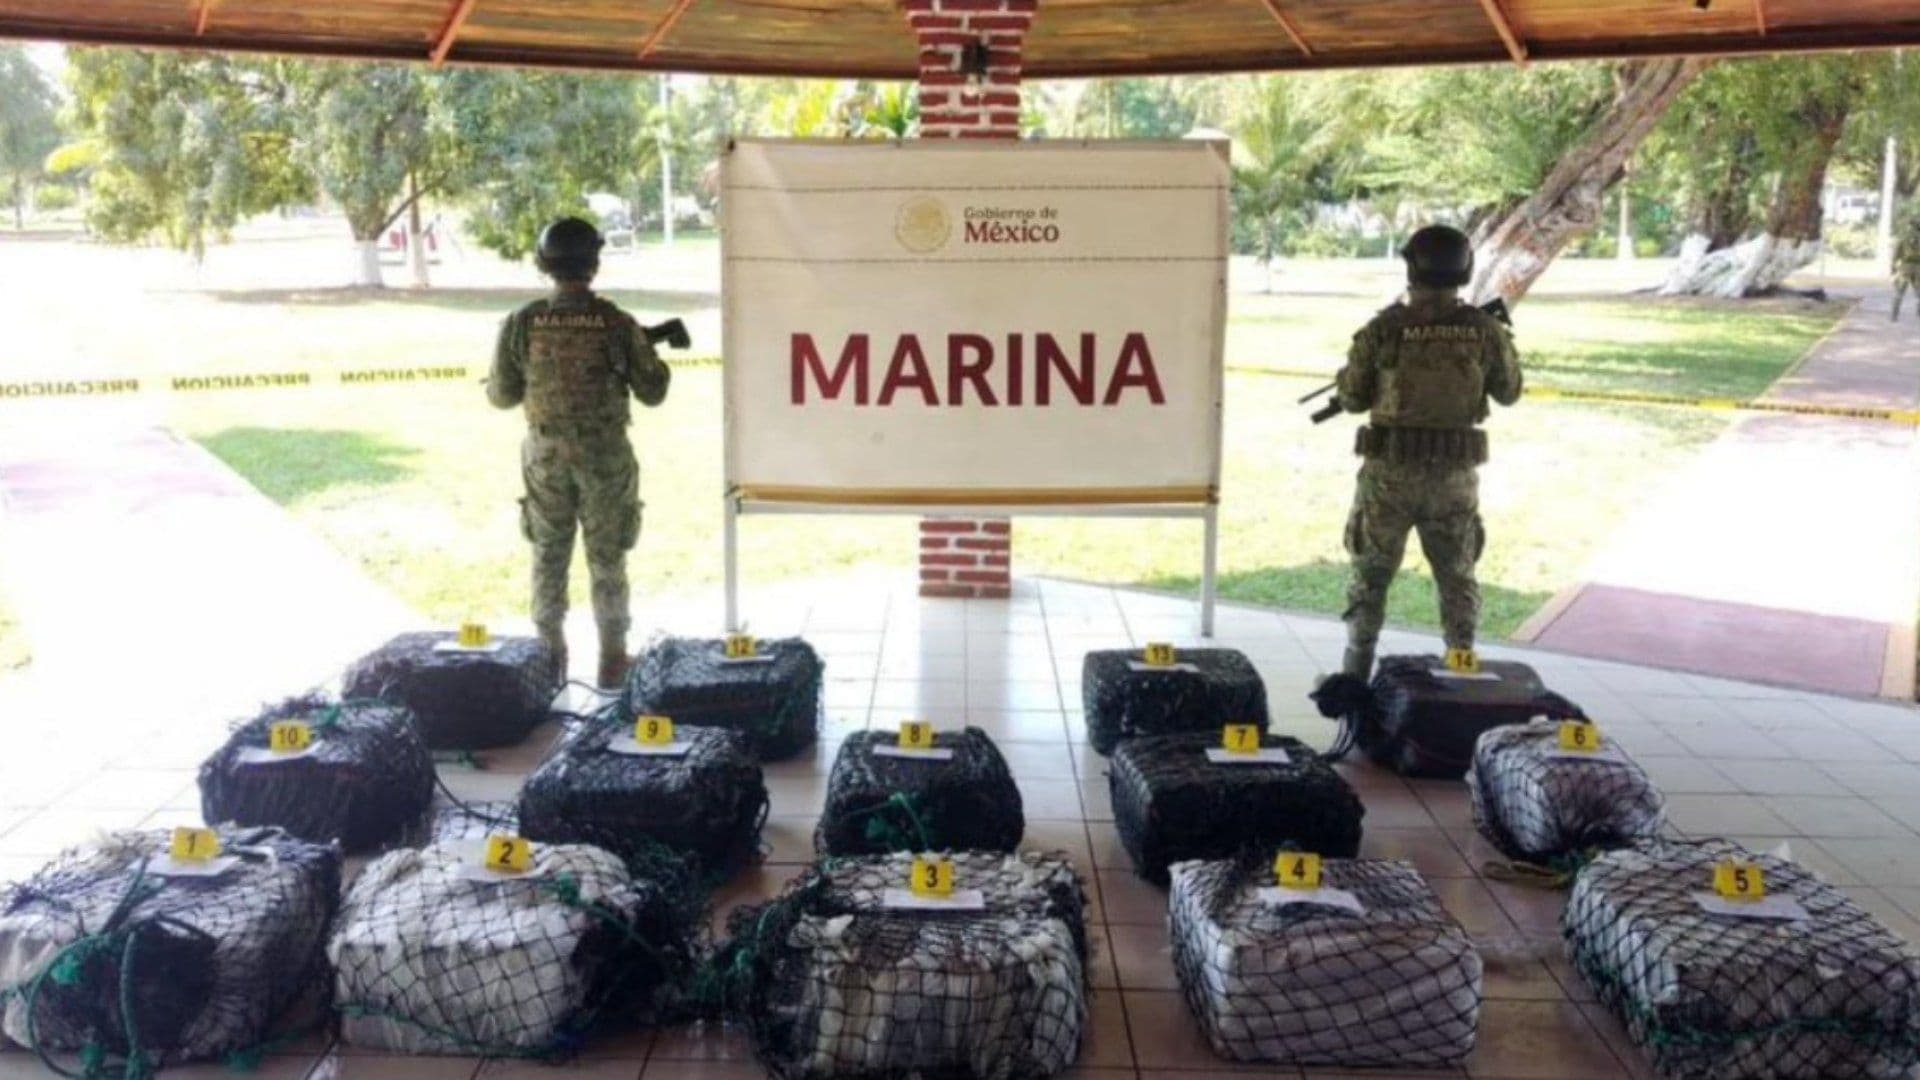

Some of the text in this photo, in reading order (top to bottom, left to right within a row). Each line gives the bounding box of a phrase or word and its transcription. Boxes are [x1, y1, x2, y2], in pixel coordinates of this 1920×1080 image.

[963, 206, 1059, 219] Gobierno de
[963, 219, 1060, 243] México
[533, 313, 606, 329] MARINA
[1402, 325, 1478, 341] MARINA
[790, 332, 1166, 406] MARINA
[732, 637, 749, 654] 12
[1456, 653, 1472, 668] 14
[278, 727, 298, 744] 10
[648, 720, 658, 738] 9
[909, 724, 920, 743] 8
[1236, 729, 1247, 747] 7
[1574, 727, 1585, 745] 6
[499, 841, 513, 864] 2
[925, 865, 938, 888] 3
[1292, 857, 1305, 880] 4
[1734, 869, 1748, 892] 5
